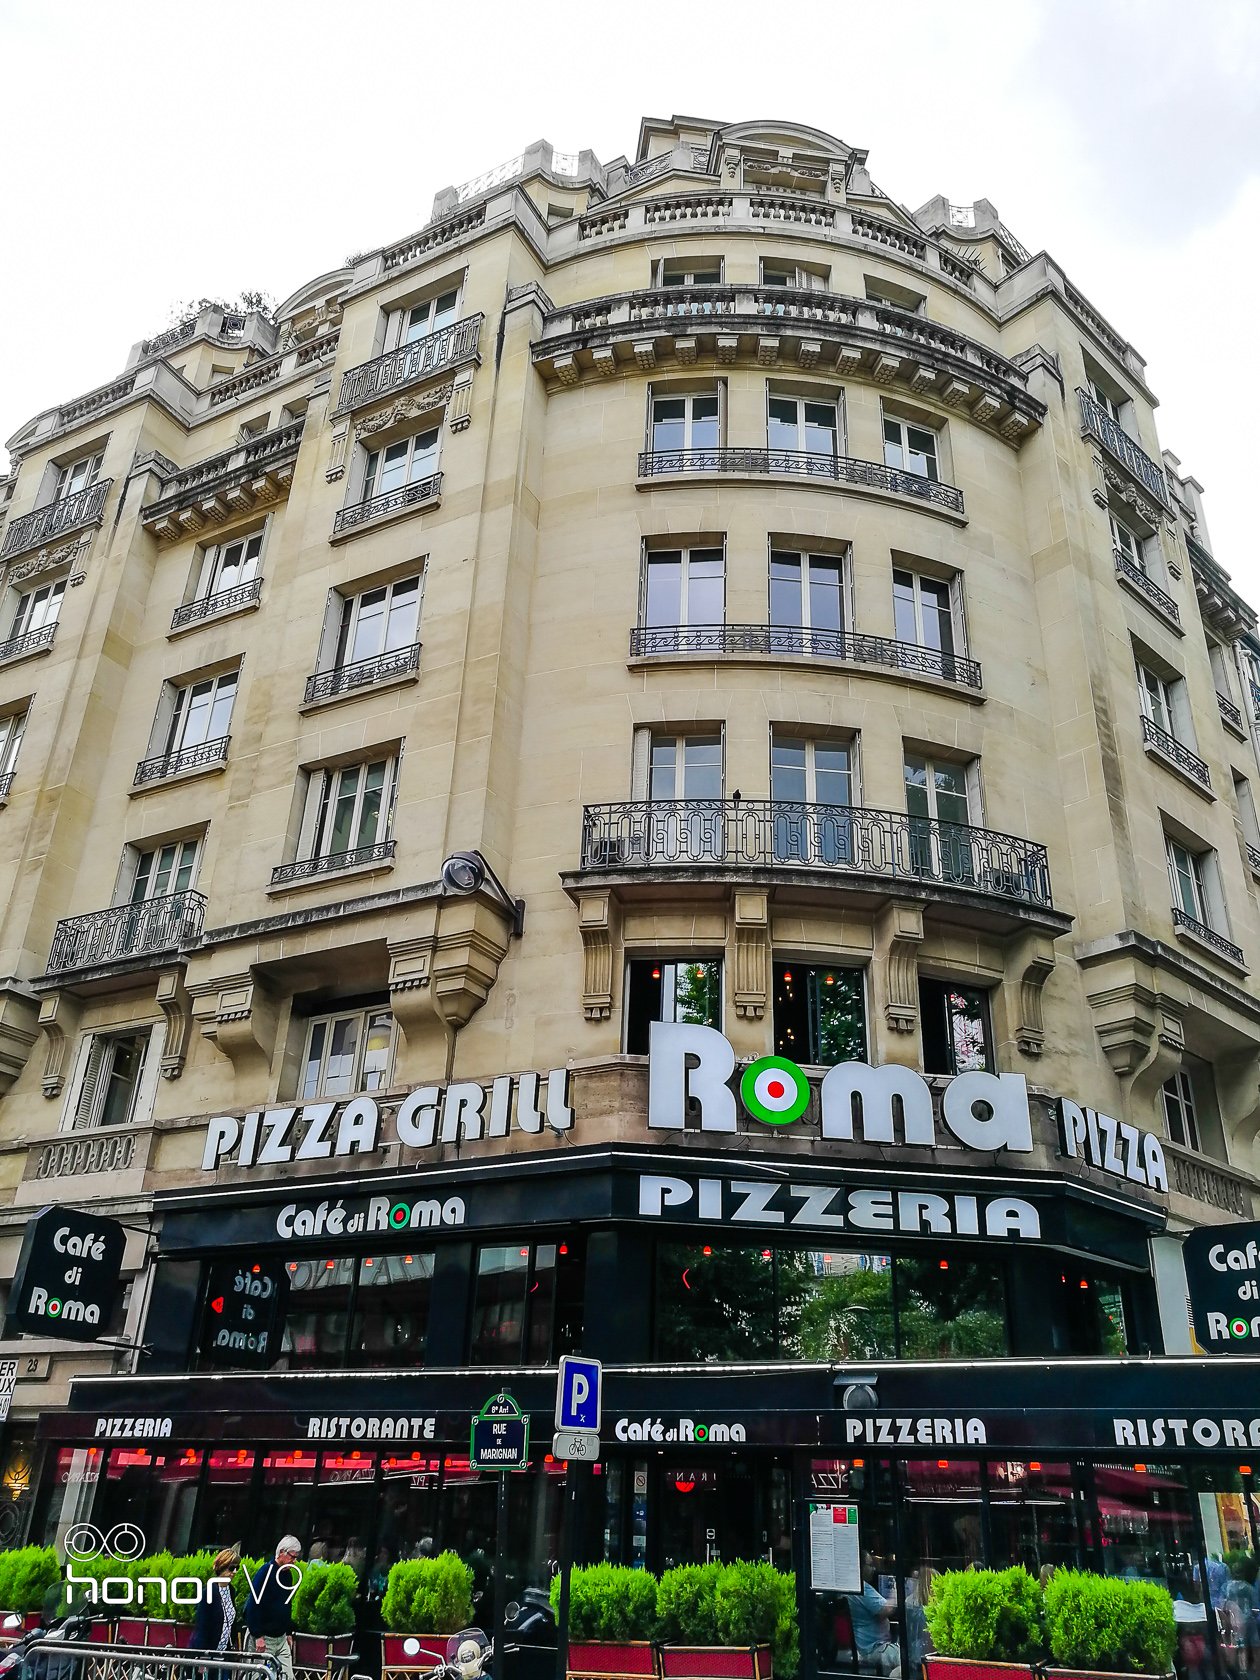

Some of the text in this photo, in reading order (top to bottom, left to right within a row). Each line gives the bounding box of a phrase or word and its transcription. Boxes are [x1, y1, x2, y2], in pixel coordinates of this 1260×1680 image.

[649, 1021, 1033, 1152] Roma
[201, 1068, 576, 1171] PIZZA GRILL
[1060, 1097, 1169, 1193] PIZZA
[276, 1196, 466, 1239] Café di Roma
[638, 1174, 1042, 1239] PIZZERIA
[53, 1226, 106, 1261] Café
[1208, 1240, 1260, 1272] Caf
[64, 1266, 82, 1286] di
[1237, 1280, 1259, 1301] di
[28, 1286, 101, 1324] Roma
[571, 1373, 589, 1416] P
[94, 1417, 173, 1438] PIZZERIA
[306, 1416, 437, 1439] RISTORANTE
[492, 1423, 508, 1435] RUE
[614, 1418, 747, 1442] Café di Roma
[845, 1417, 987, 1444] PIZZERIA
[480, 1447, 518, 1460] MARIGNAN
